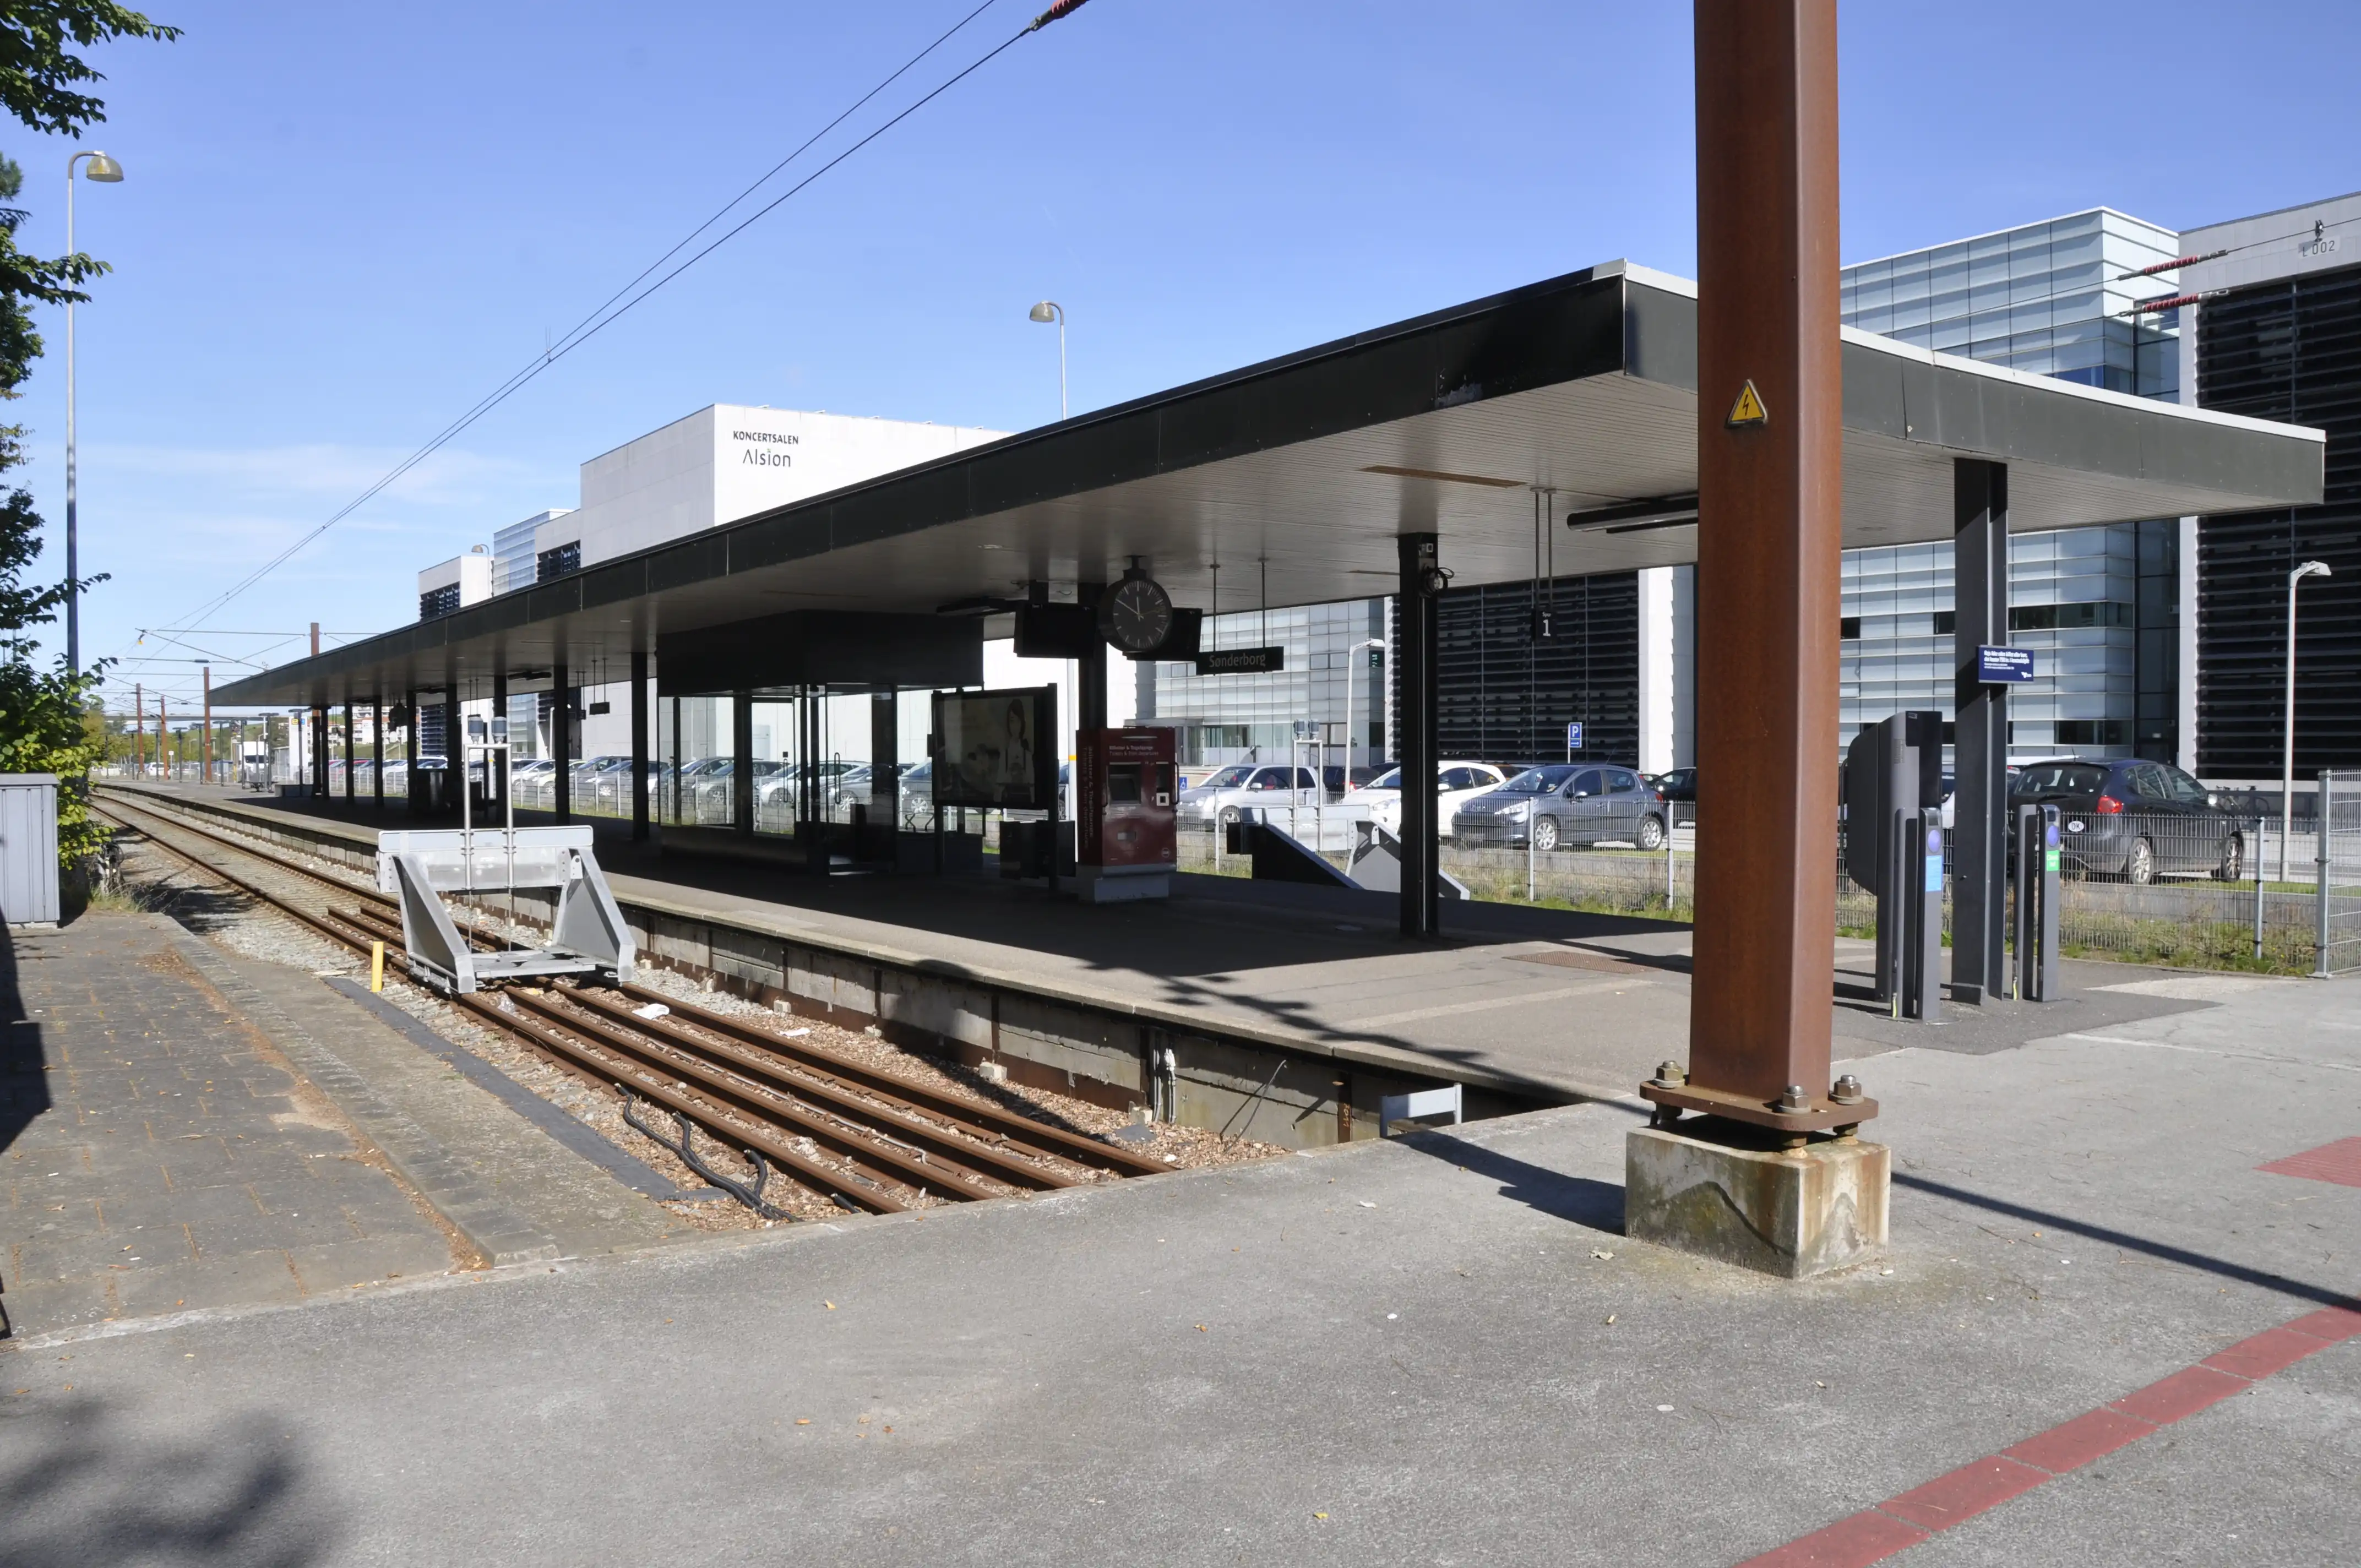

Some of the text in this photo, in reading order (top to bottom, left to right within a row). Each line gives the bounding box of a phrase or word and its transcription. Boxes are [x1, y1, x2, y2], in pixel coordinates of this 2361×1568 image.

[2303, 240, 2335, 257] L 002
[733, 430, 799, 445] KONCERTSALEN
[742, 448, 791, 468] Alsion
[1543, 619, 1551, 637] 1
[1209, 652, 1266, 668] Sønderborg
[1572, 726, 1579, 738] P
